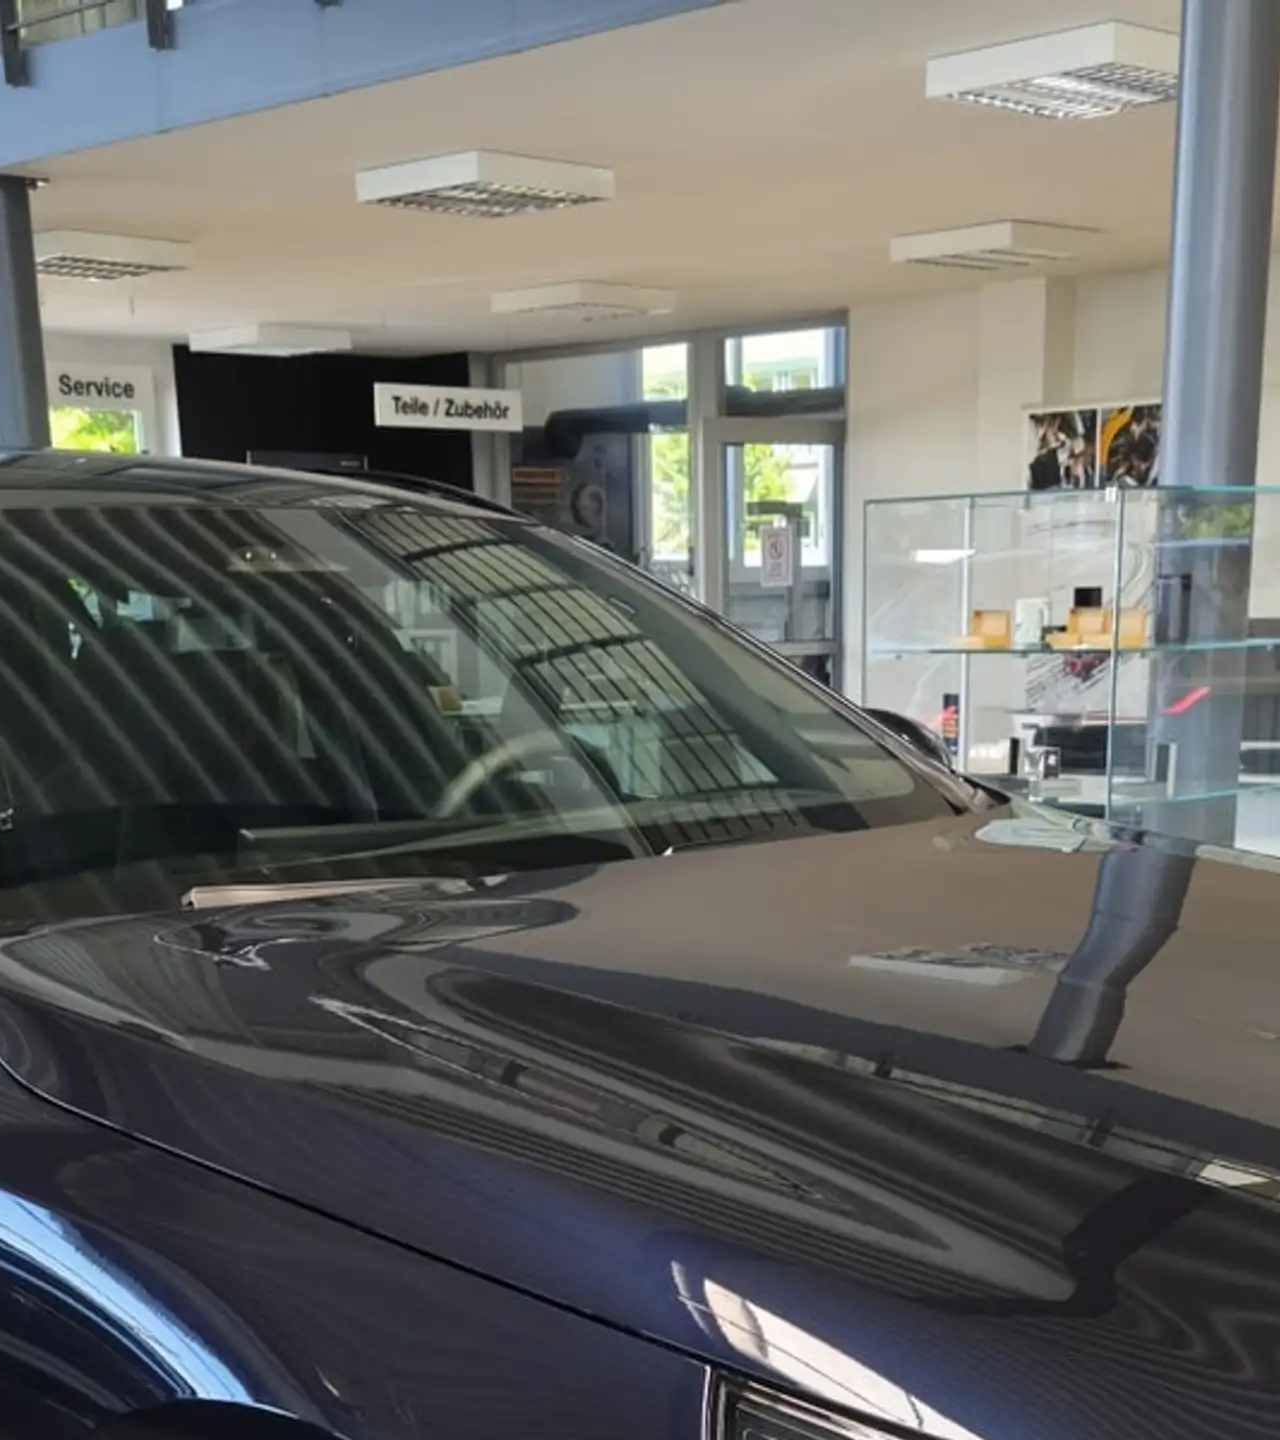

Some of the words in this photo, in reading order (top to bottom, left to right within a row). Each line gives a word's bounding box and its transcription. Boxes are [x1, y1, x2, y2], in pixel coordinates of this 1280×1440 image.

[58, 373, 135, 399] Service
[392, 395, 429, 416] Teile
[445, 398, 510, 420] Zubehör
